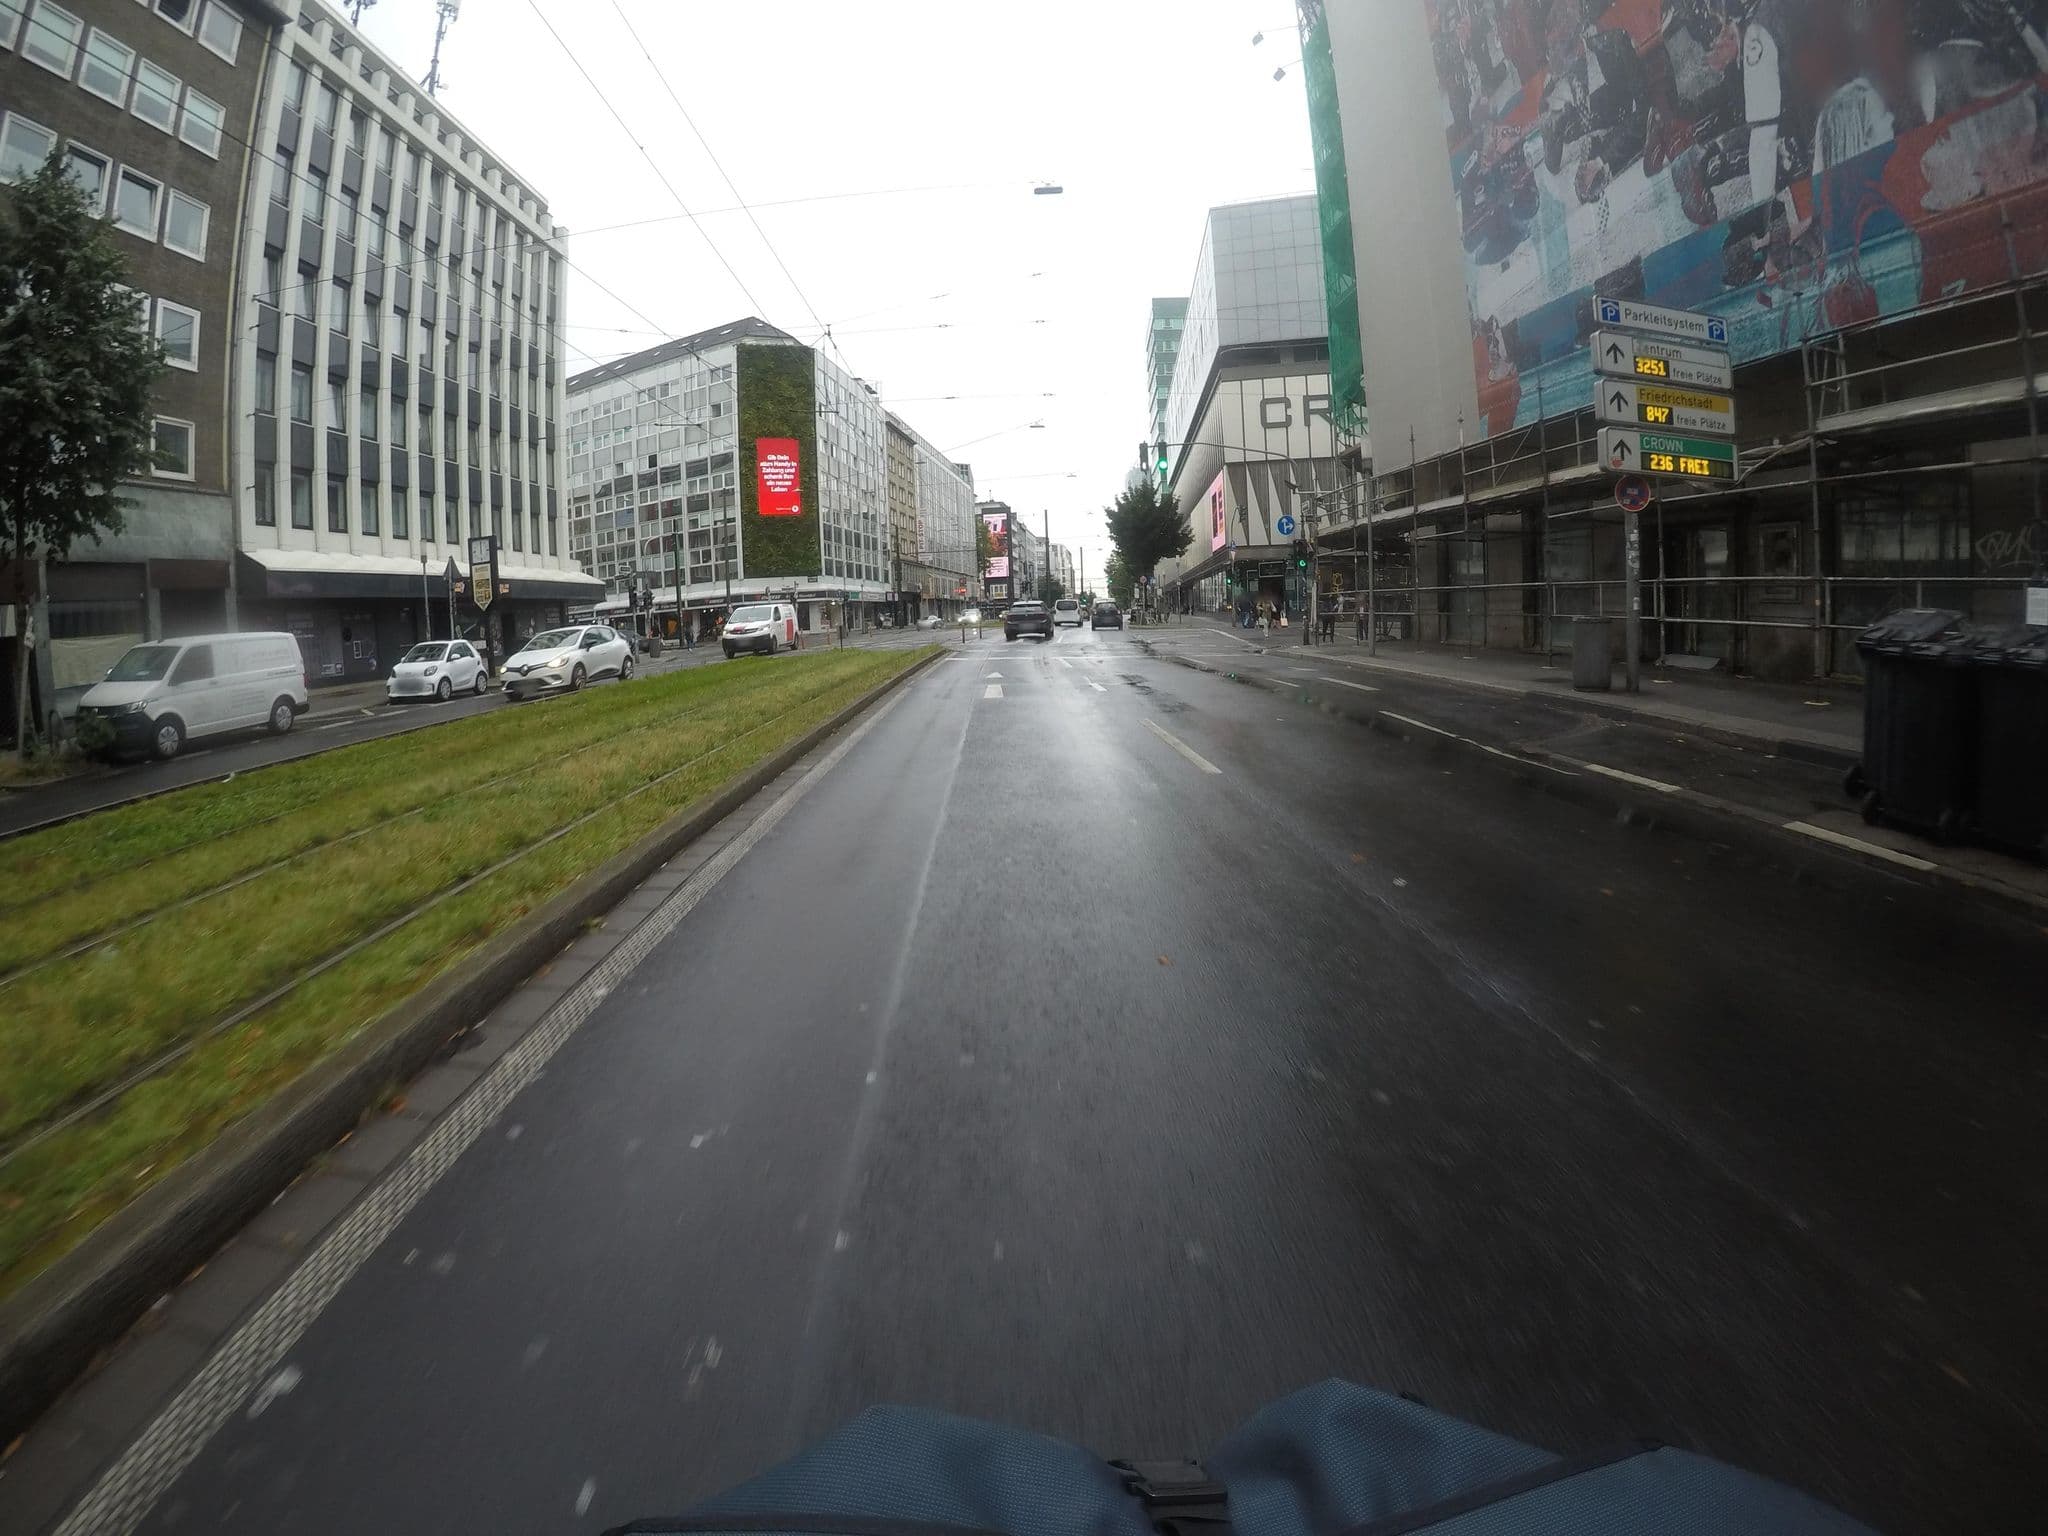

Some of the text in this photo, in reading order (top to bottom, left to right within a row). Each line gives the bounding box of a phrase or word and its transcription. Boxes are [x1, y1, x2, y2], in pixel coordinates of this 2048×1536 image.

[1624, 308, 1705, 332] Parkleitsystem
[1635, 357, 1723, 385] 3251 freie Plätze
[1639, 388, 1713, 409] Friedrichstadt
[1646, 406, 1726, 430] 847 freie Plätze
[1643, 437, 1684, 453] CROWN
[1650, 454, 1710, 475] 236 FREI
